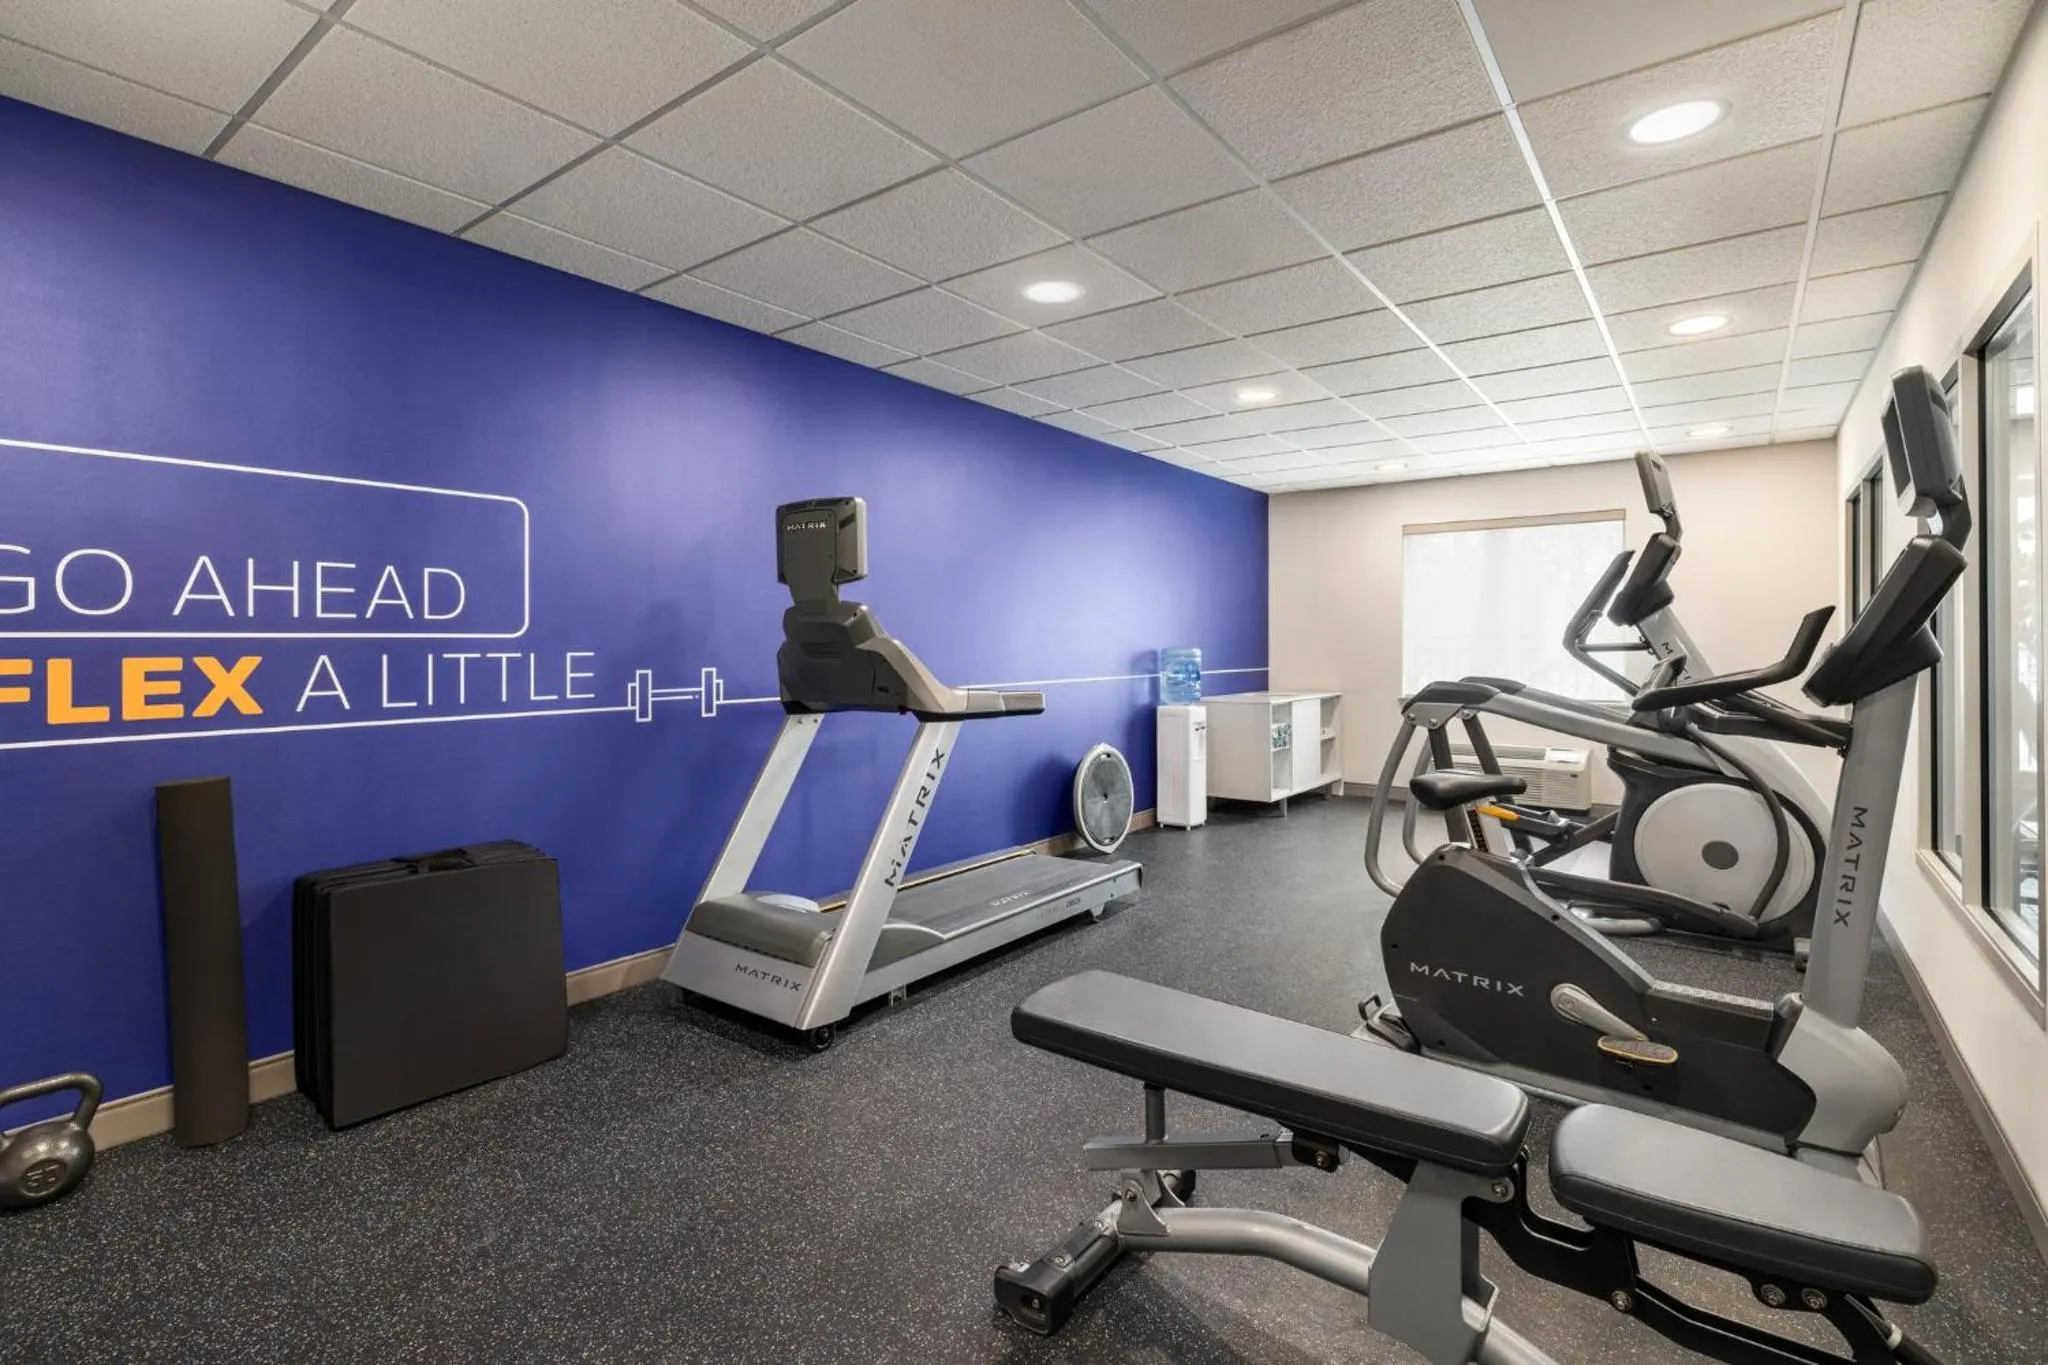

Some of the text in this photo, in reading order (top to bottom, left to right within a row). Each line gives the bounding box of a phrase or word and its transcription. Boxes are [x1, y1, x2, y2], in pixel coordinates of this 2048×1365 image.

[172, 555, 465, 620] AHEAD
[296, 654, 351, 712] A
[382, 652, 595, 708] LITTLE
[884, 747, 945, 888] MATRIX
[1833, 805, 1869, 928] MATRIX
[735, 963, 802, 992] MATRIX
[1409, 961, 1526, 998] MATRIX
